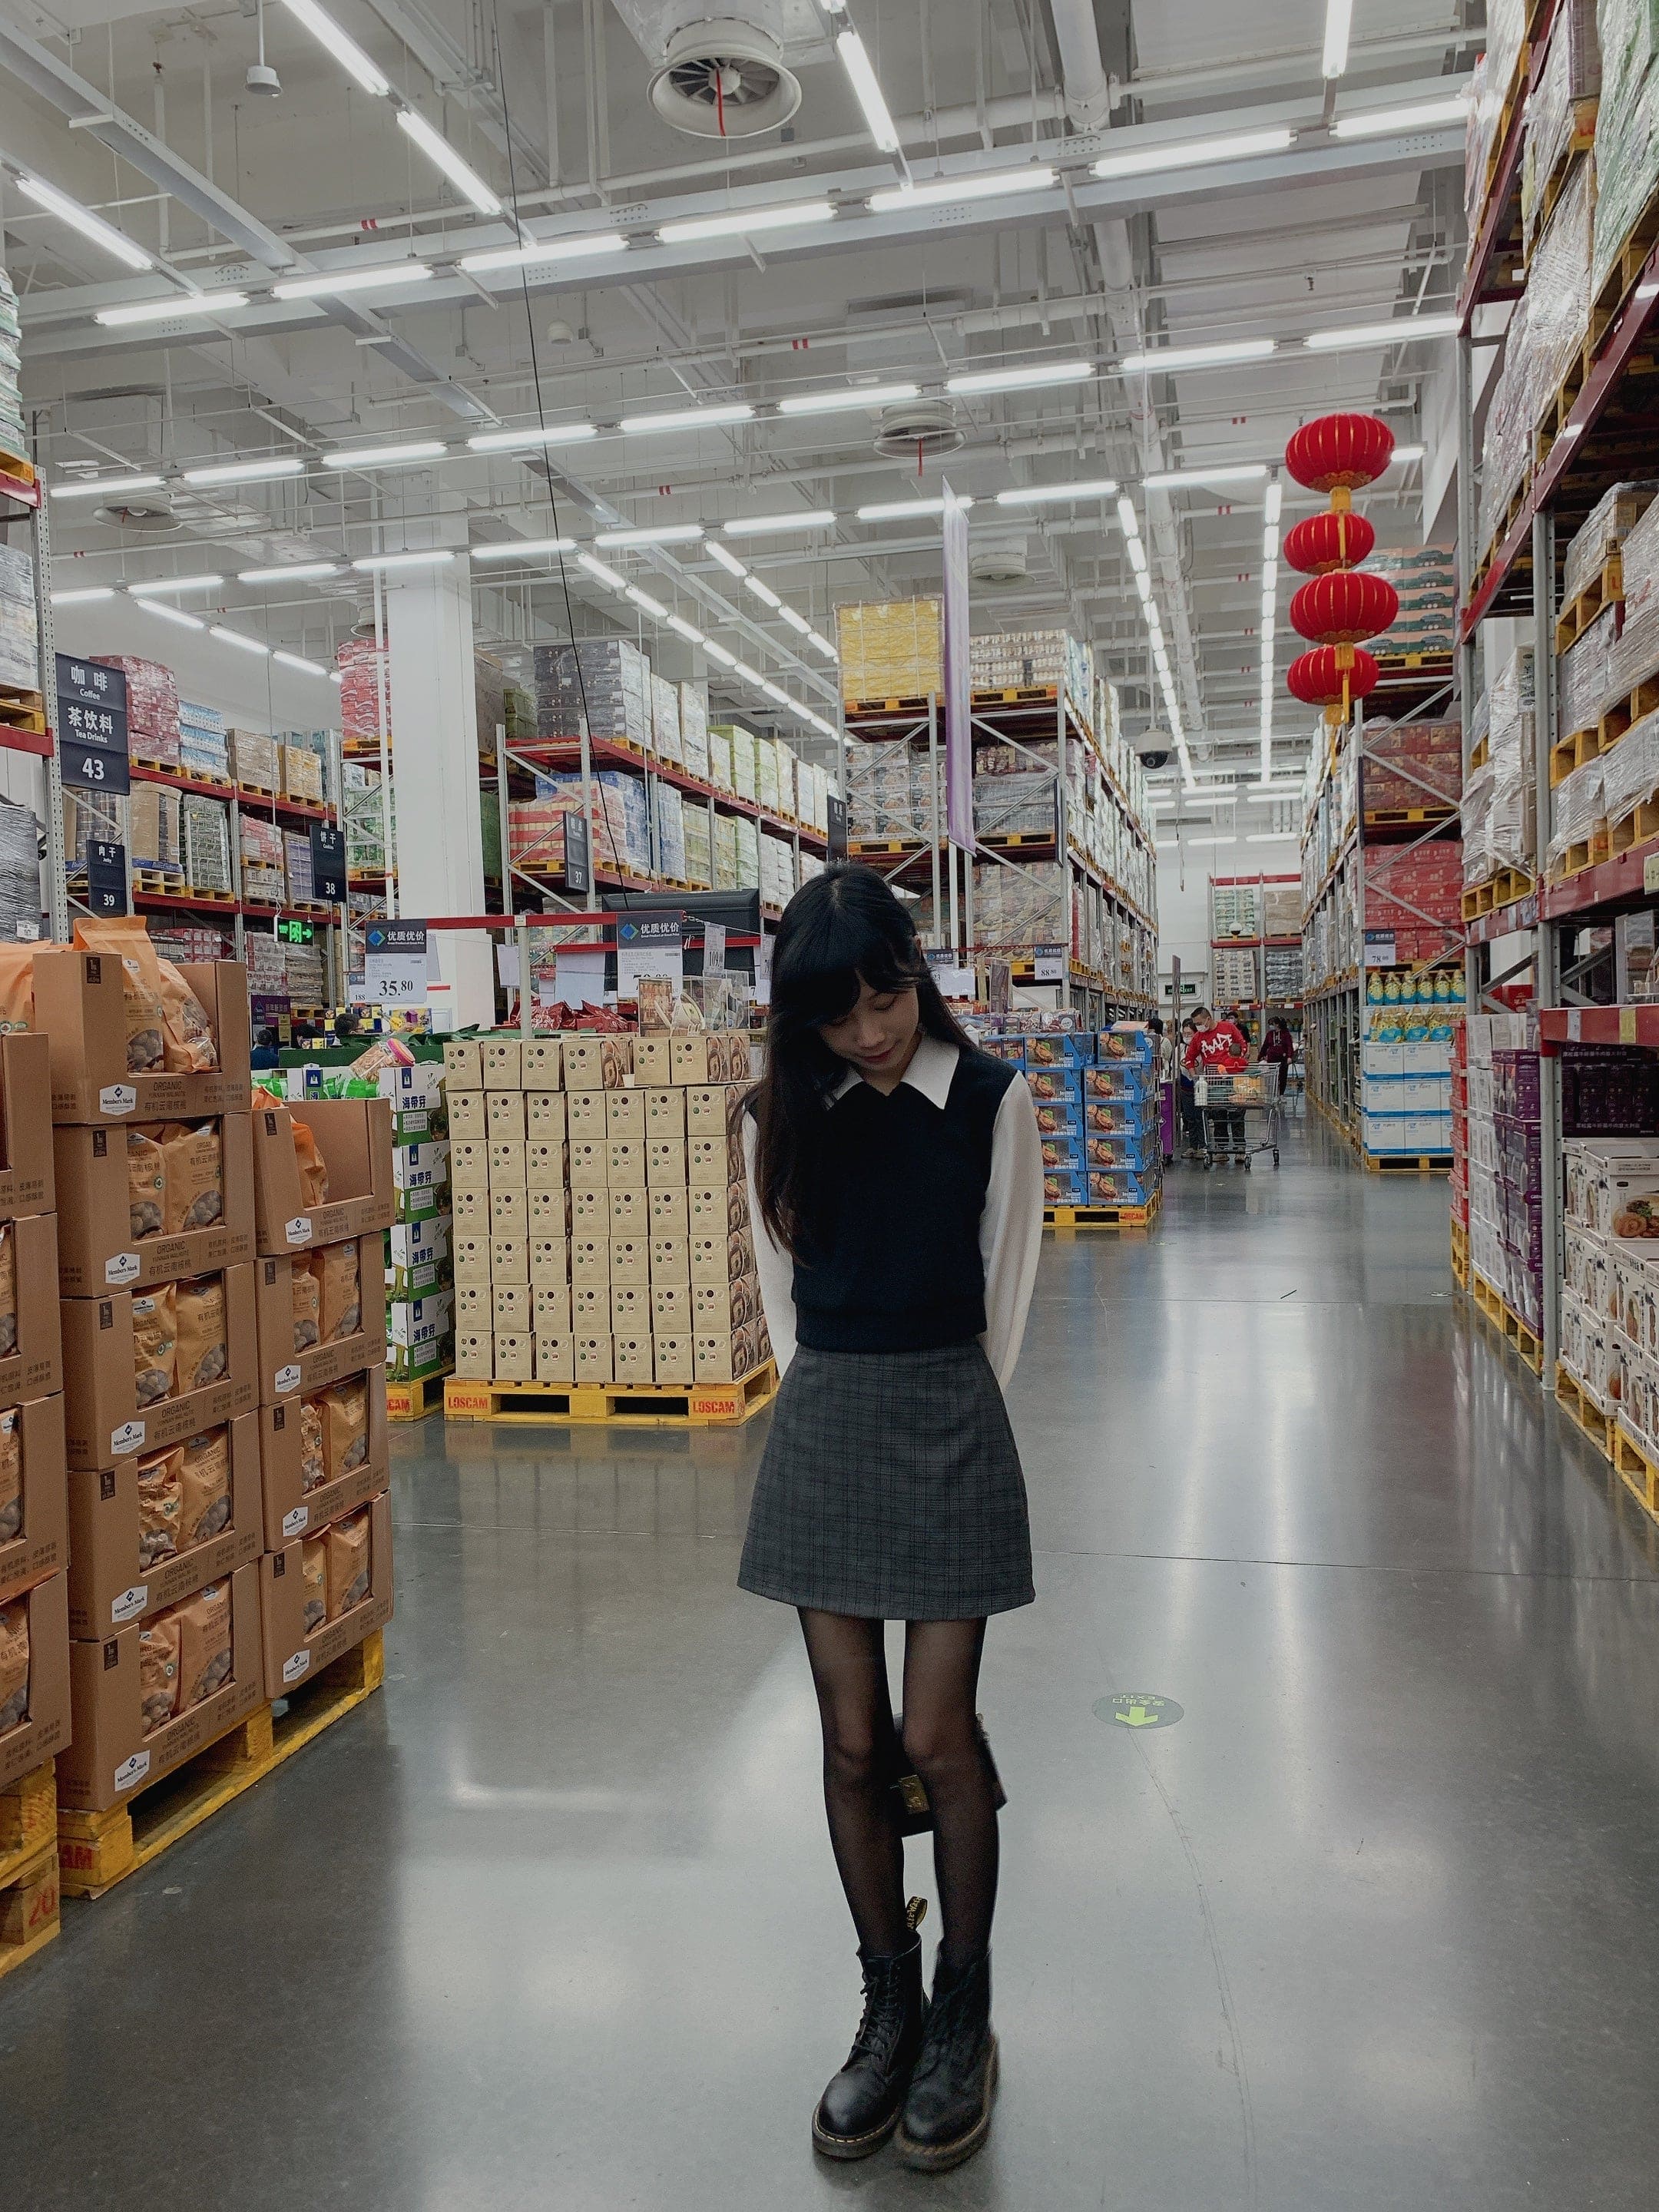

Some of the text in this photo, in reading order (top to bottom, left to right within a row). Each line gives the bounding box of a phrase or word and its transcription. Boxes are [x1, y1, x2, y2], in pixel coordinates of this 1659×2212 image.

[70, 665, 108, 692] 咖啡
[79, 688, 101, 700] Coffee
[68, 705, 114, 735] 茶饮料
[75, 729, 108, 743] Tea Drinks
[81, 757, 104, 780] 43
[575, 870, 582, 884] 37
[325, 882, 336, 895] 38
[103, 894, 115, 906] 39
[641, 922, 680, 934] 优质优价
[387, 930, 425, 942] 优质优价
[379, 980, 413, 996] 35.80
[153, 1081, 181, 1091] ORGANIC
[402, 1095, 426, 1109] 海带芽
[409, 1171, 432, 1186] 海带芽
[157, 1241, 186, 1254] ORGANIC
[412, 1247, 434, 1265] 海带芽
[413, 1323, 435, 1343] 海带芽
[161, 1401, 190, 1418] ORGANIC
[448, 1397, 488, 1409] LOSCAM
[693, 1401, 734, 1413] LOSCAM
